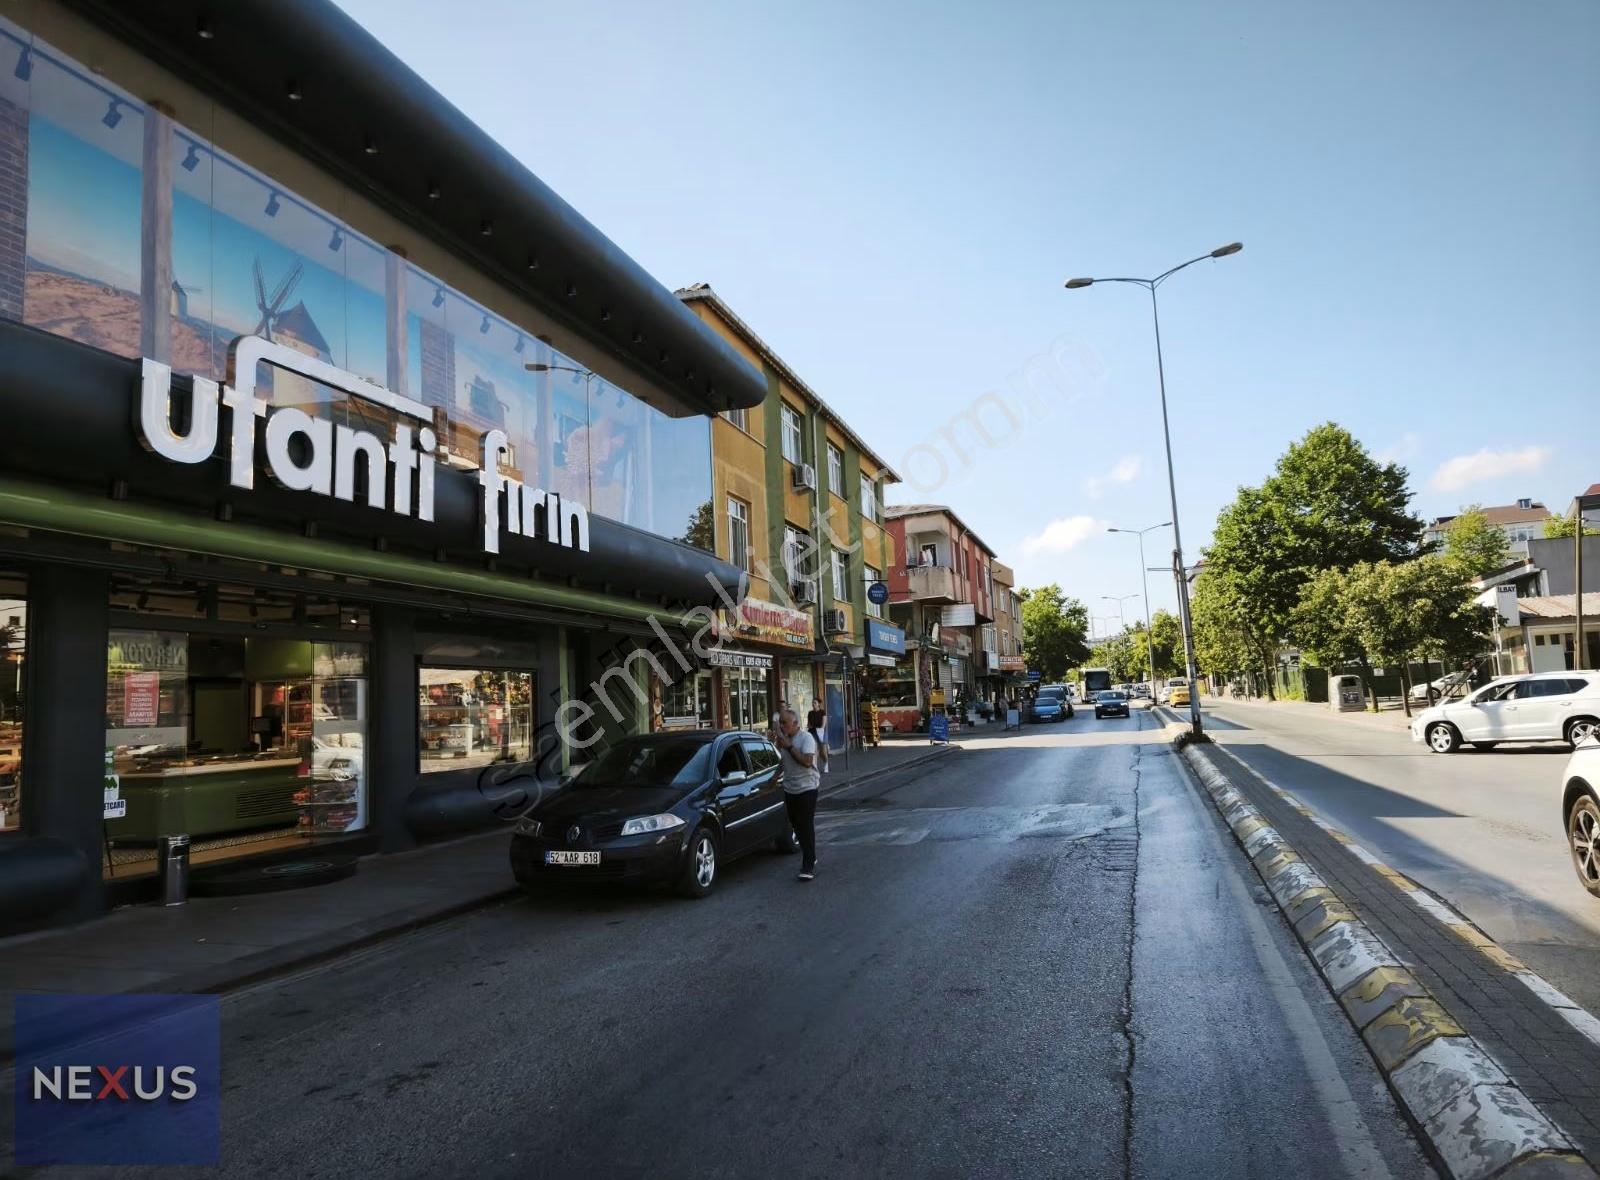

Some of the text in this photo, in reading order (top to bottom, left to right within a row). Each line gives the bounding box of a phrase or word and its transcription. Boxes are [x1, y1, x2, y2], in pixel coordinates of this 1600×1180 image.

[140, 334, 436, 523] ufanti
[551, 853, 598, 863] 52 AAR 618
